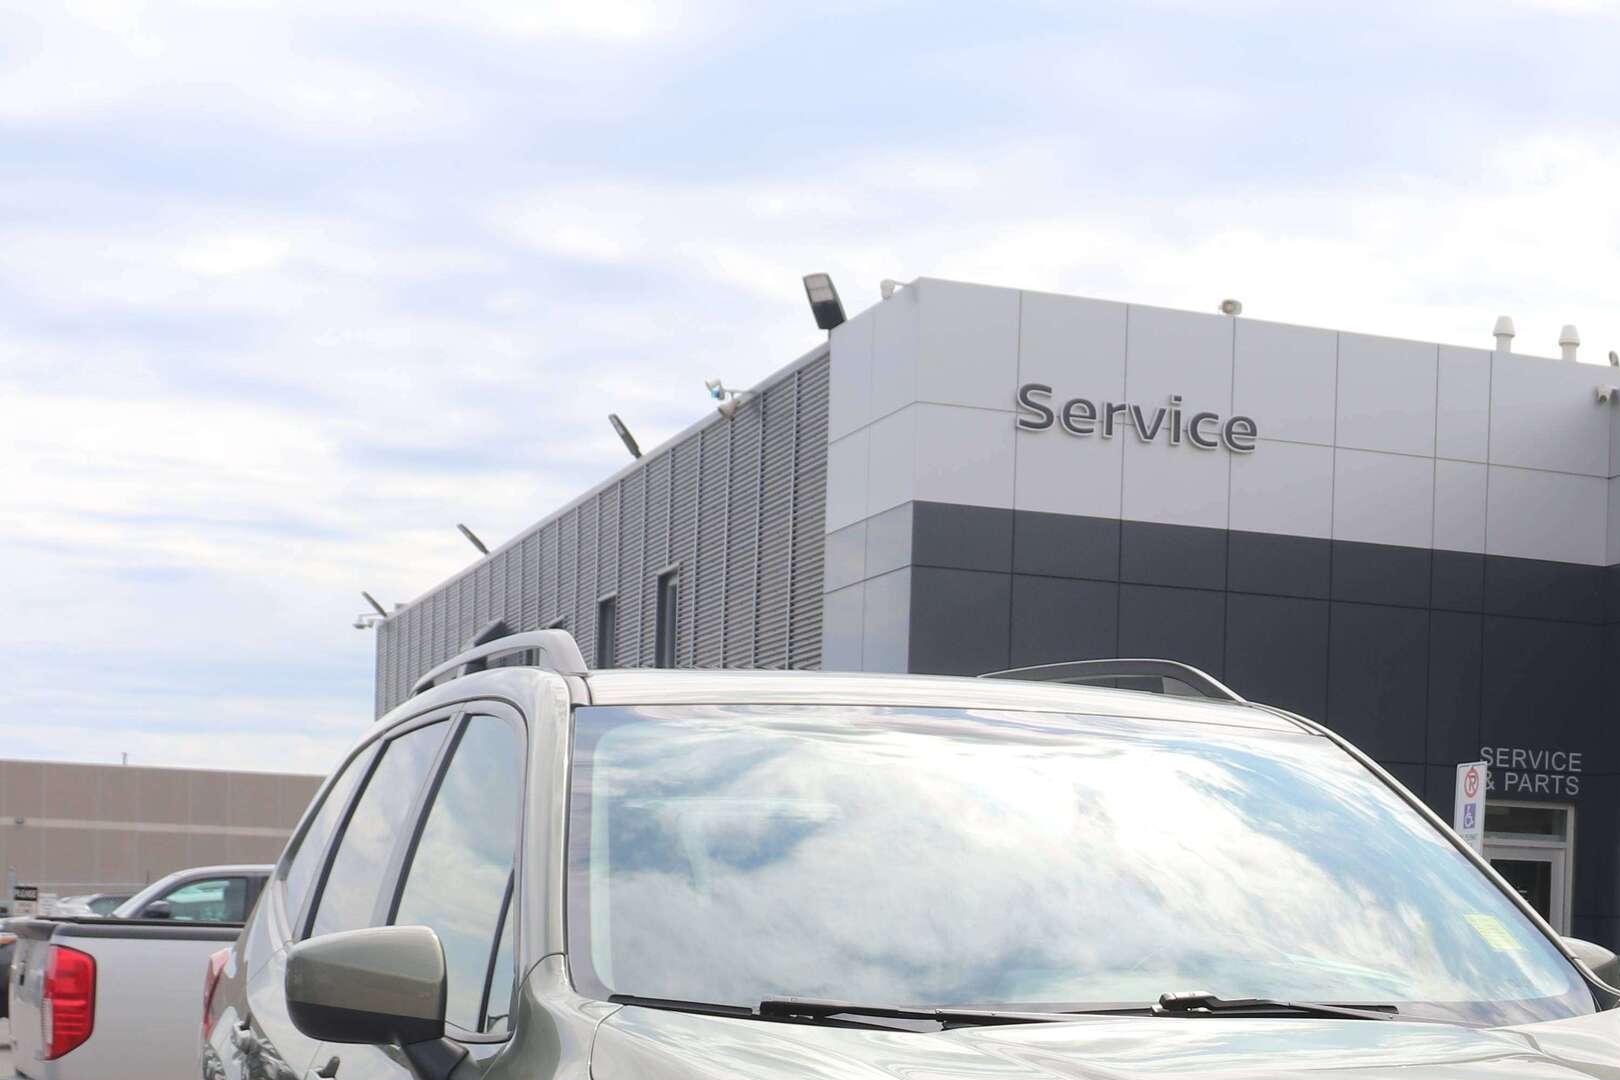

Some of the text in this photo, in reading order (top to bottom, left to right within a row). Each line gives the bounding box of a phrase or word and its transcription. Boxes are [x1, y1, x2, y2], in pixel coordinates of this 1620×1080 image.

[1016, 382, 1258, 452] Service
[1480, 747, 1582, 772] SERVICE
[1504, 772, 1580, 795] PARTS
